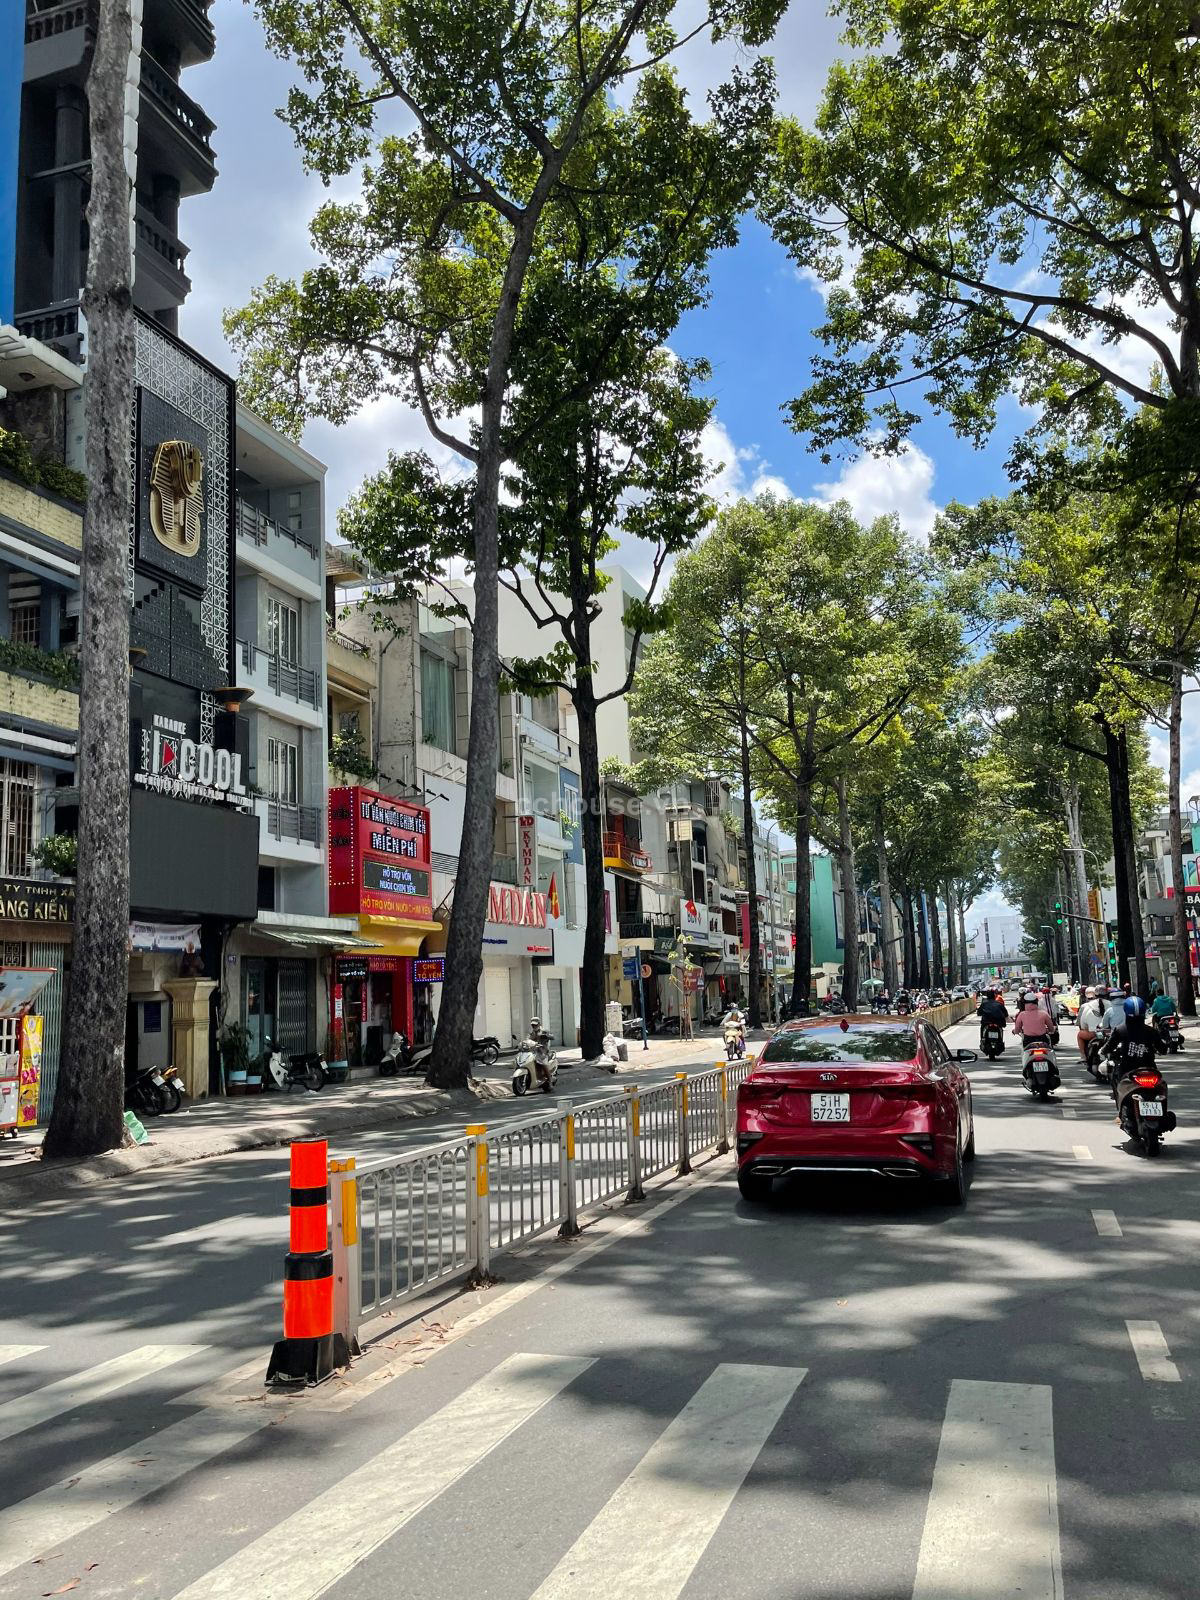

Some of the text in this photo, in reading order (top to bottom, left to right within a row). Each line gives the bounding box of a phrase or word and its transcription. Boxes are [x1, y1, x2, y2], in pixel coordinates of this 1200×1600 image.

[153, 714, 186, 735] KARAOKE
[372, 827, 399, 855] MIỄN
[401, 837, 417, 858] PHÍ
[522, 830, 532, 885] KYMDAN
[4, 884, 20, 893] TY
[25, 886, 57, 896] TNHH
[34, 897, 68, 920] KIẾN
[820, 1095, 841, 1107] 51H
[813, 1107, 848, 1120] 572.57
